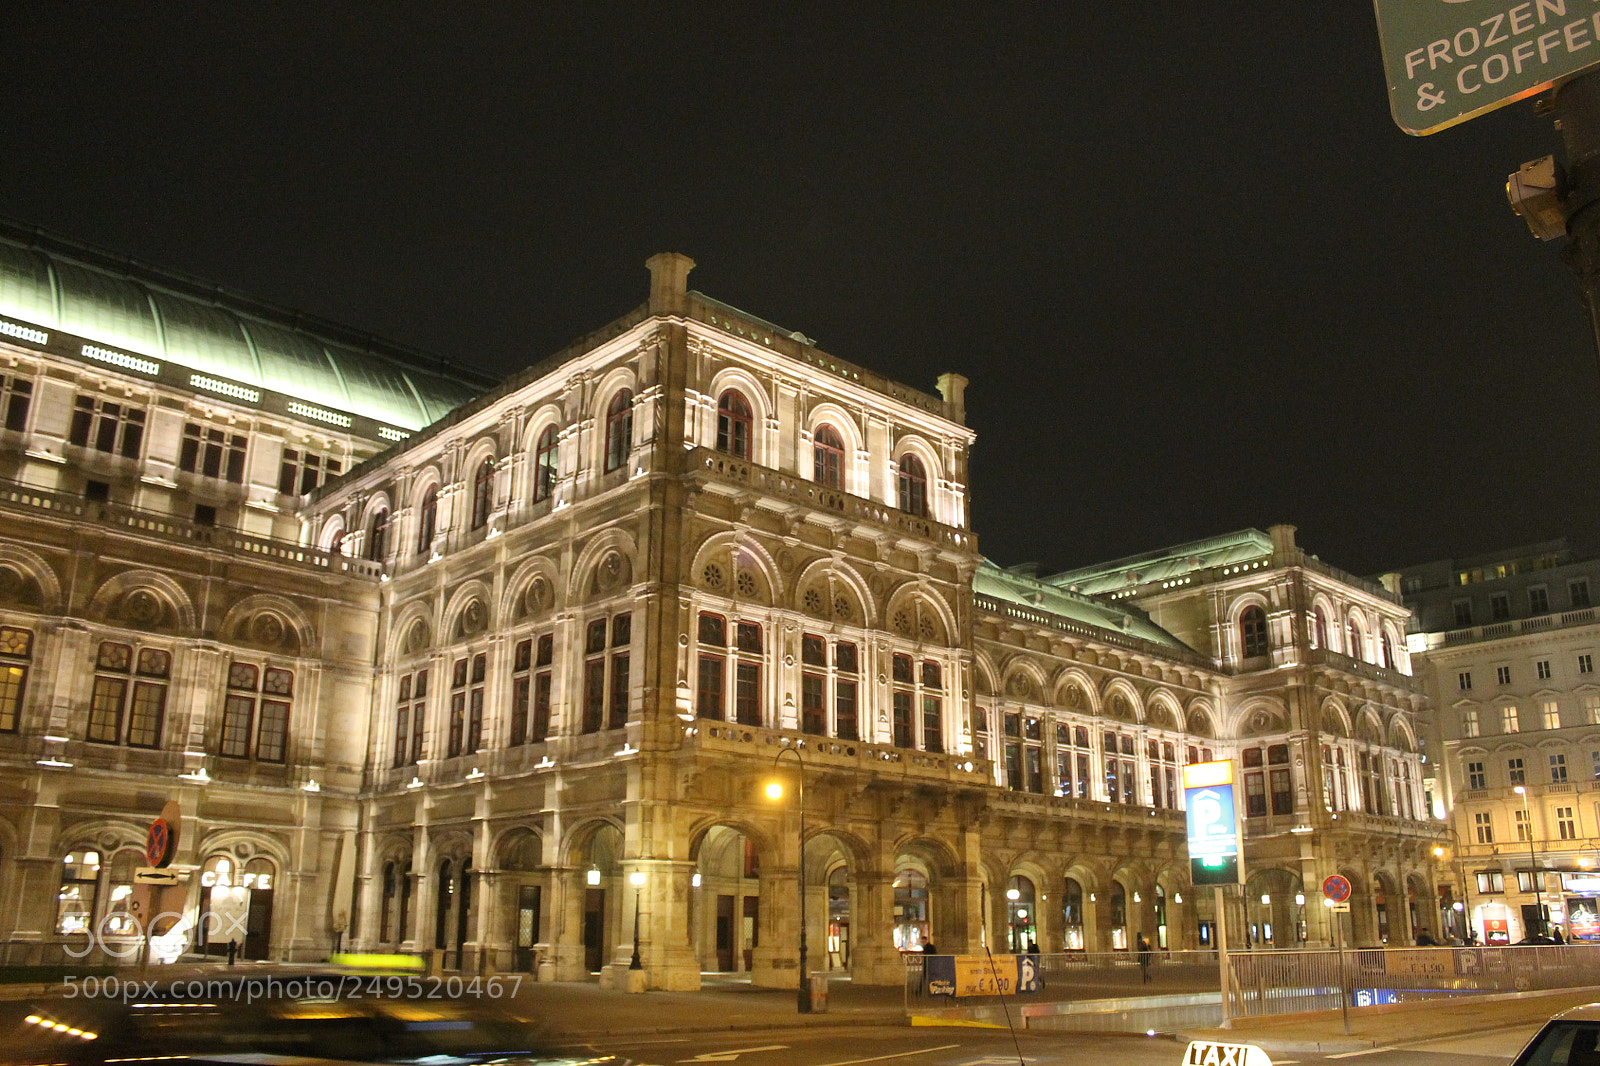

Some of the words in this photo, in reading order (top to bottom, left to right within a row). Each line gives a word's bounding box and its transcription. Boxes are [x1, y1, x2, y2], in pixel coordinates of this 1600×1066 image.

[1405, 0, 1566, 79] FROZEN
[1417, 82, 1446, 111] &
[1192, 1044, 1246, 1066] TAXI
